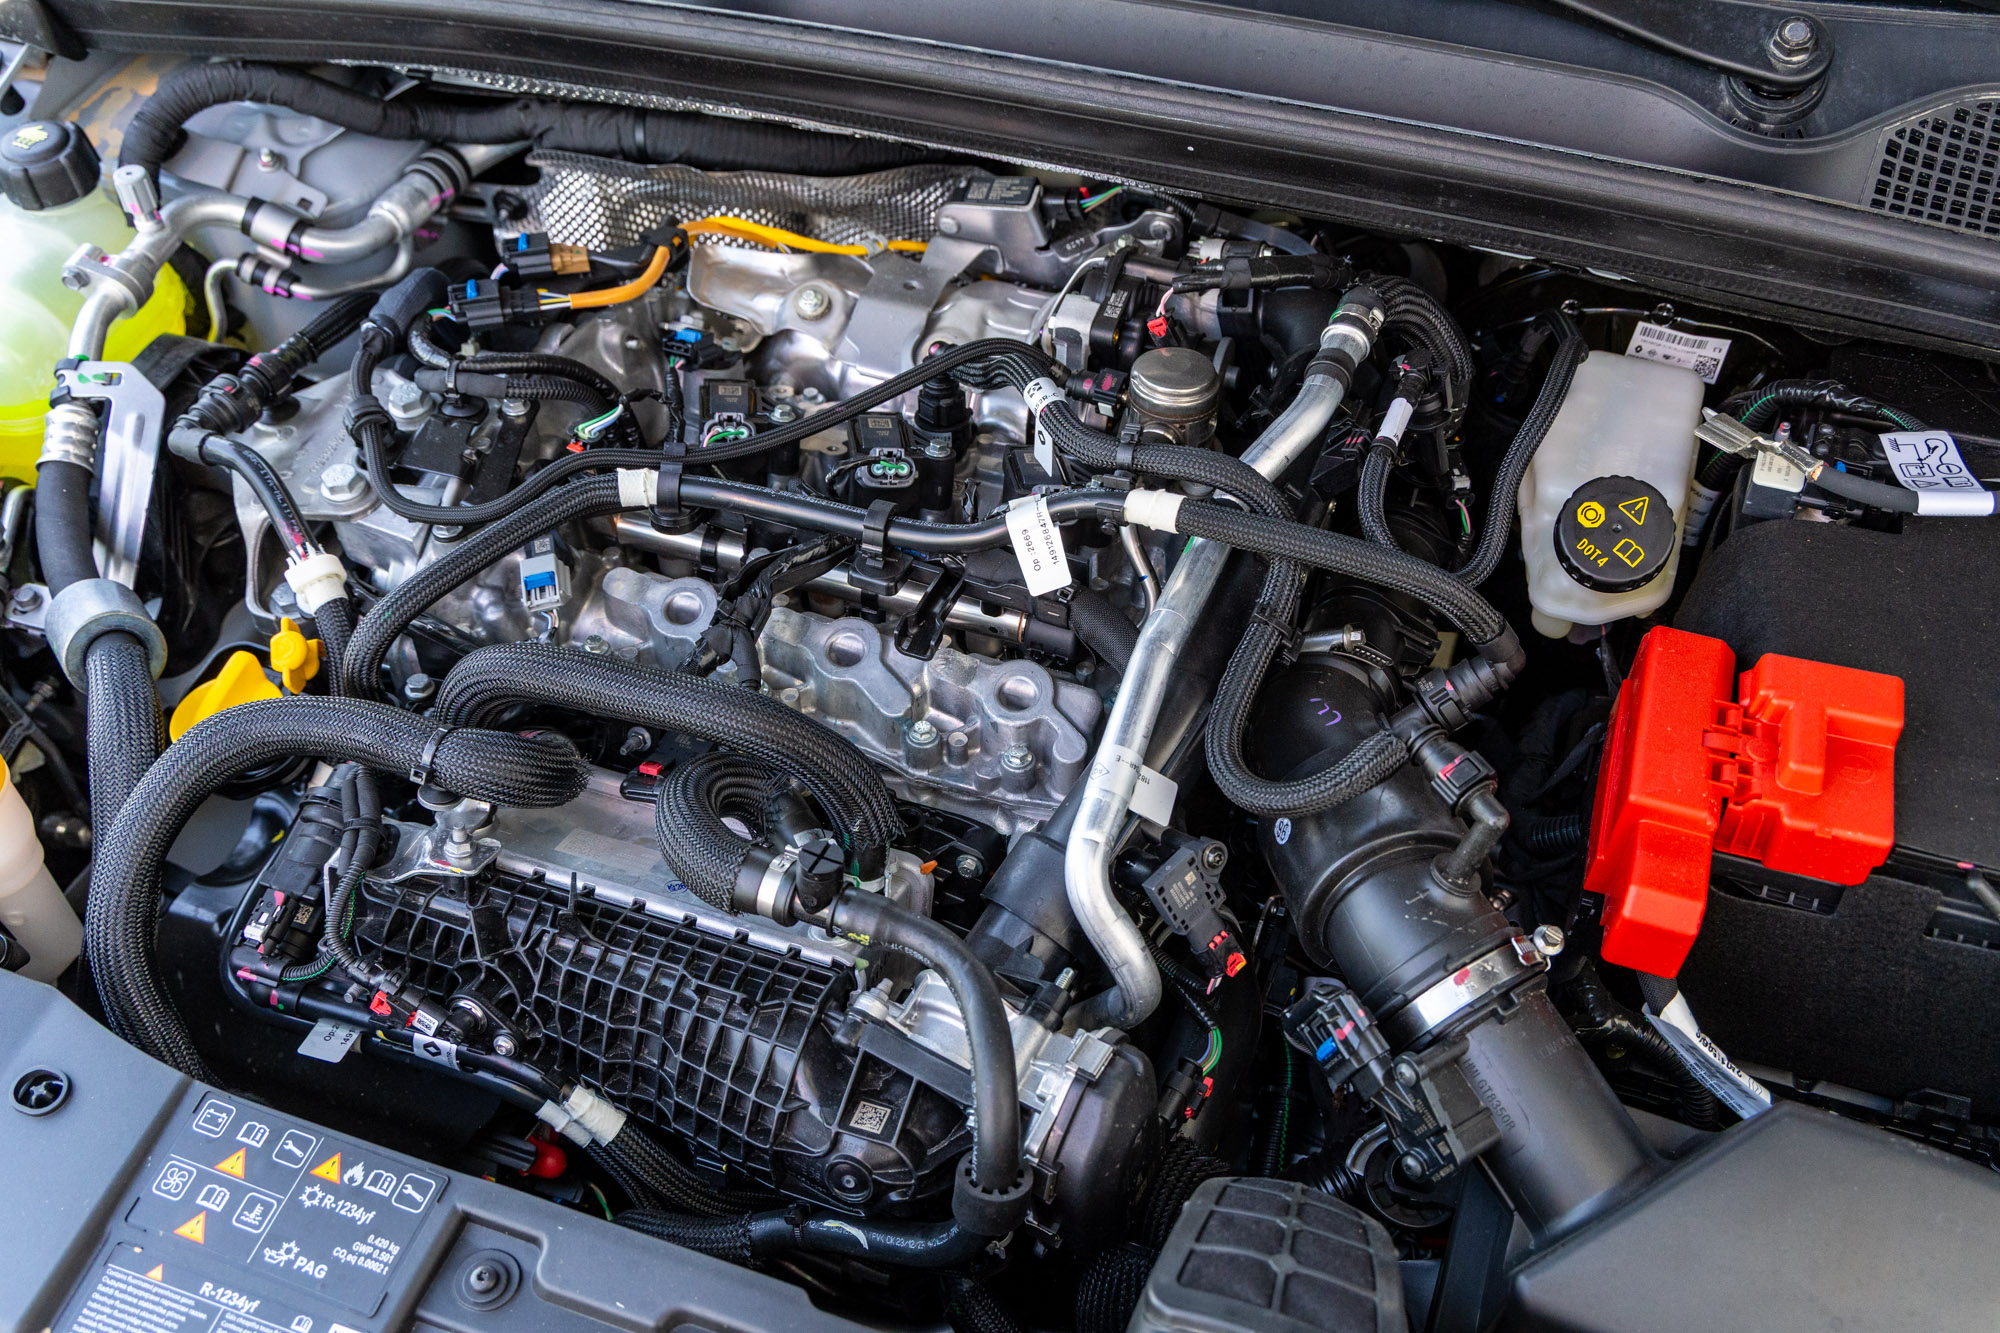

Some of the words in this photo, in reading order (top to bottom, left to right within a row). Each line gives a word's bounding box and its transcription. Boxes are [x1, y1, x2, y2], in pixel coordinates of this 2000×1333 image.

[321, 1194, 376, 1225] R-1234yf
[352, 1241, 374, 1256] GWP
[372, 1250, 394, 1264] 0.501
[367, 1234, 390, 1249] 0.420
[389, 1242, 400, 1256] kg
[293, 1256, 328, 1279] PAG
[357, 1256, 384, 1273] 0.0002
[199, 1281, 261, 1314] R-1234yf
